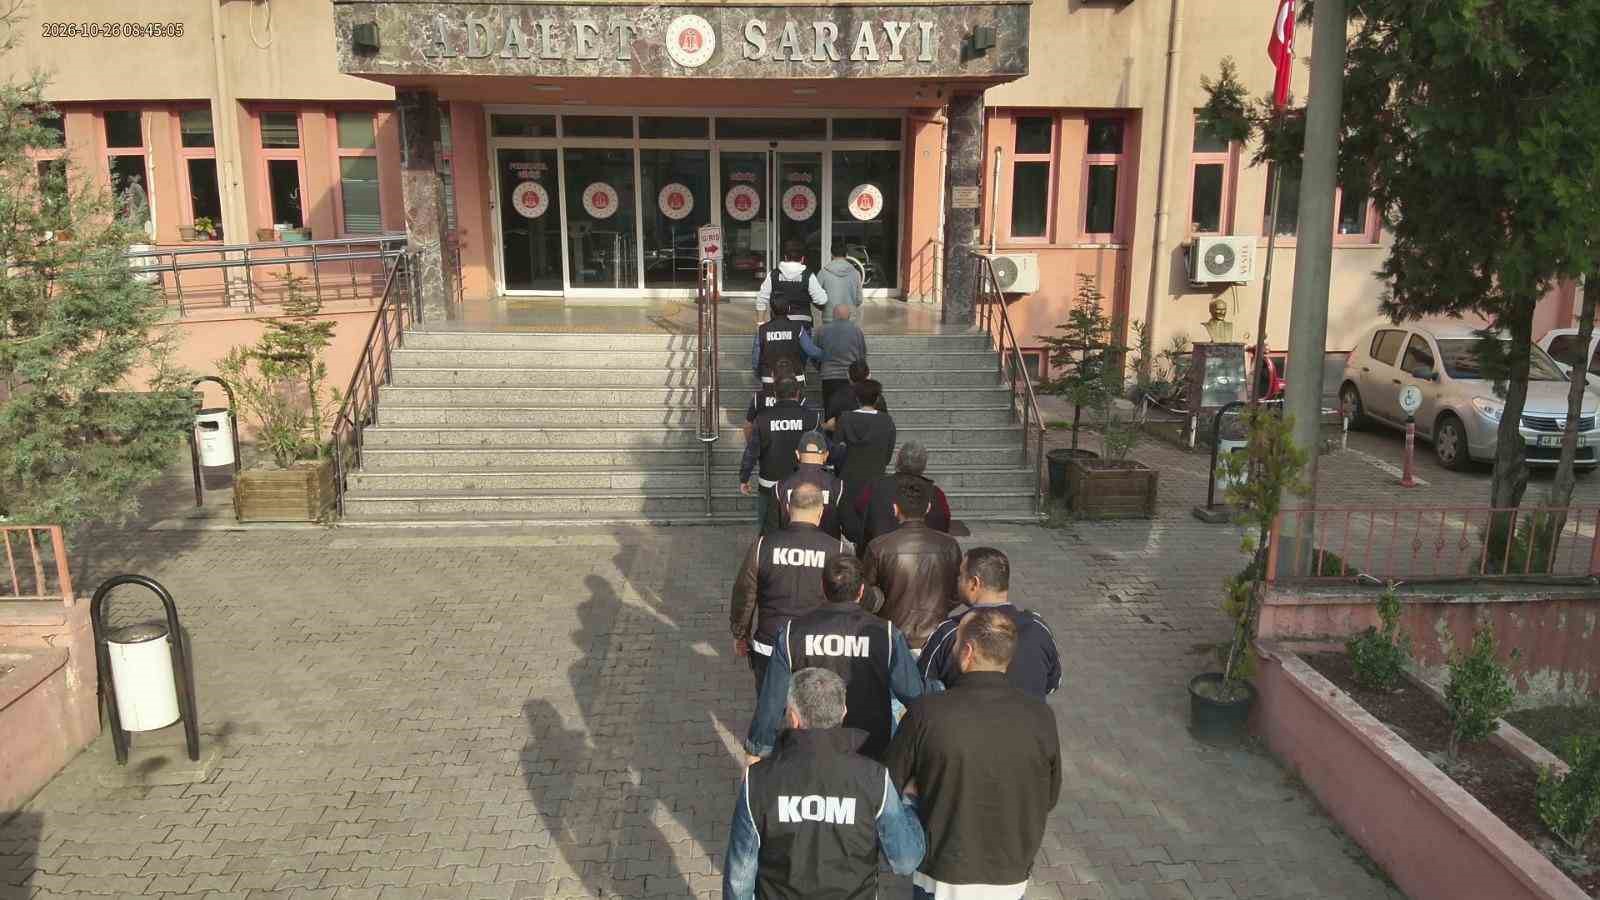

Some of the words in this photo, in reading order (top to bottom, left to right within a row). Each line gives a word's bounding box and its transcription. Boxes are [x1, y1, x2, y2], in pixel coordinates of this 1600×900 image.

[426, 14, 637, 61] ADALET
[743, 19, 937, 62] SARAYI
[766, 331, 792, 341] KOM
[770, 419, 803, 432] KOM
[772, 547, 826, 568] KOM
[804, 634, 870, 658] KOM
[777, 793, 857, 825] KOM
